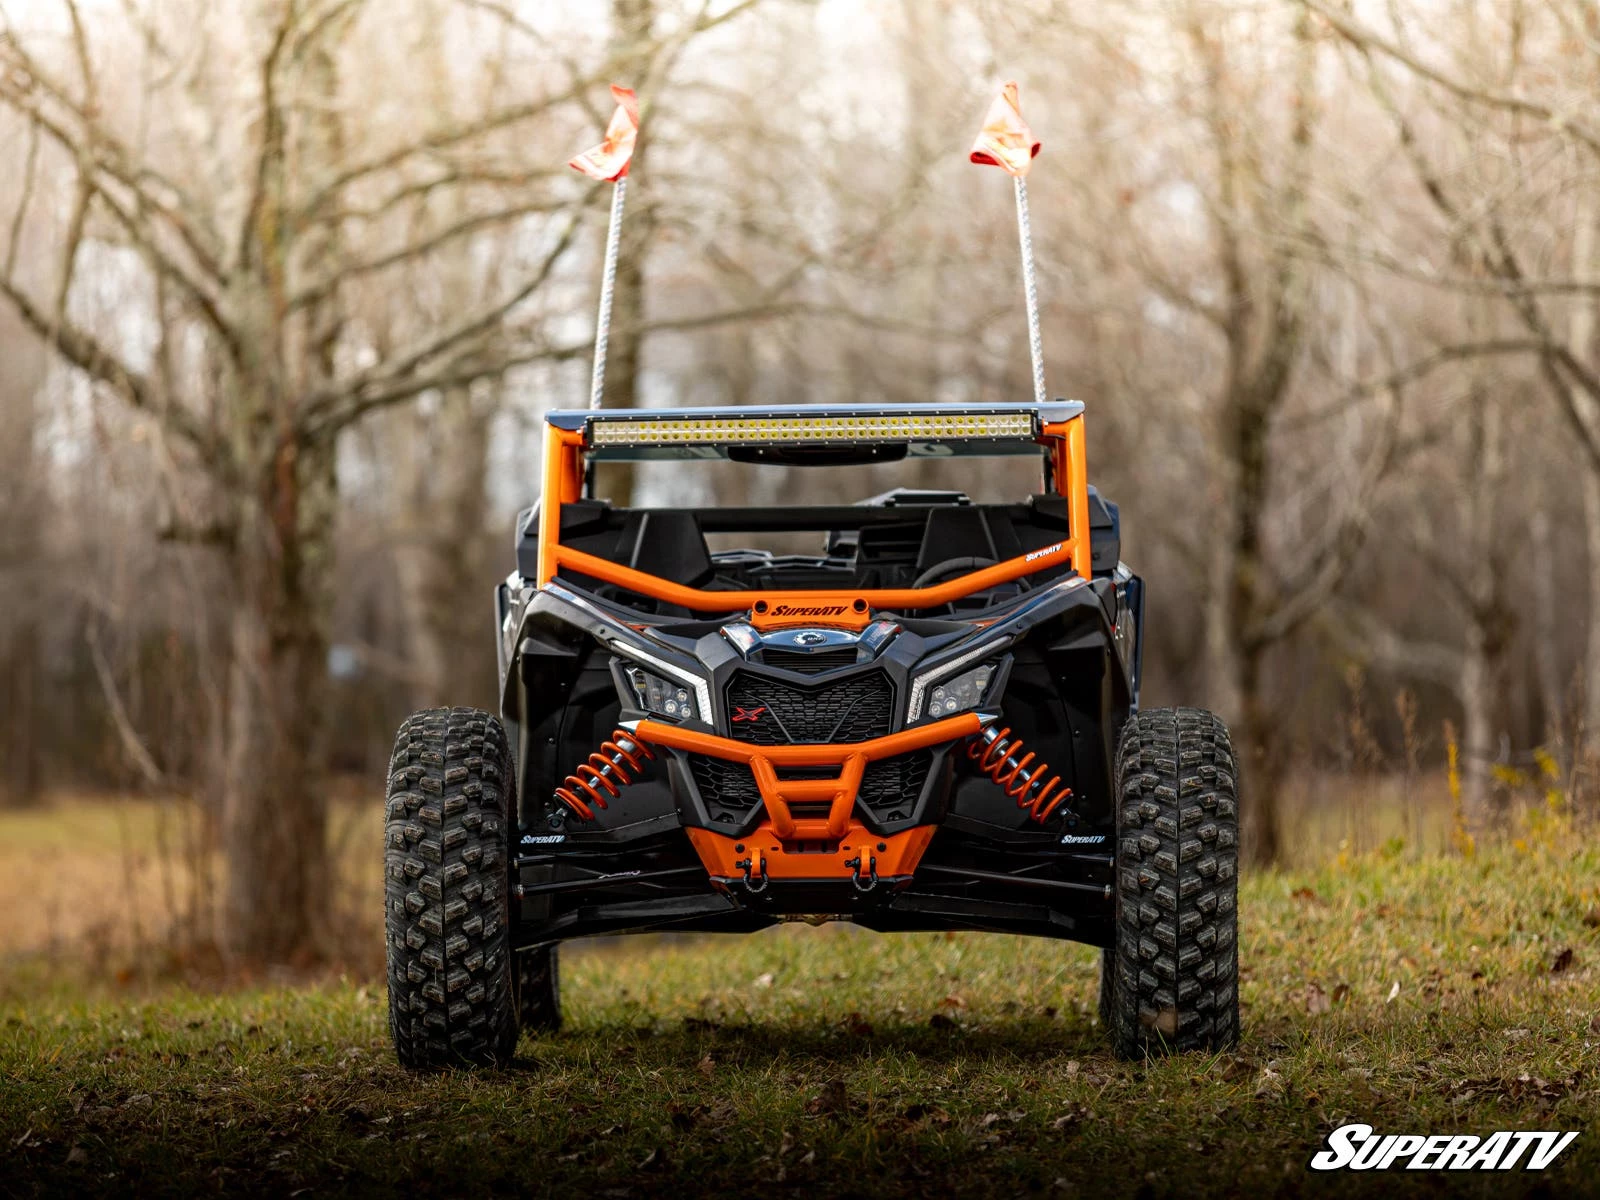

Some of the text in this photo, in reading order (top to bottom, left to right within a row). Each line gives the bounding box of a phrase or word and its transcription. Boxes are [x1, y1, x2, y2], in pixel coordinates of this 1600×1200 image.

[770, 605, 849, 617] SUPERATV
[520, 834, 566, 844] SUPERATV
[1061, 834, 1106, 844] SUPERATV
